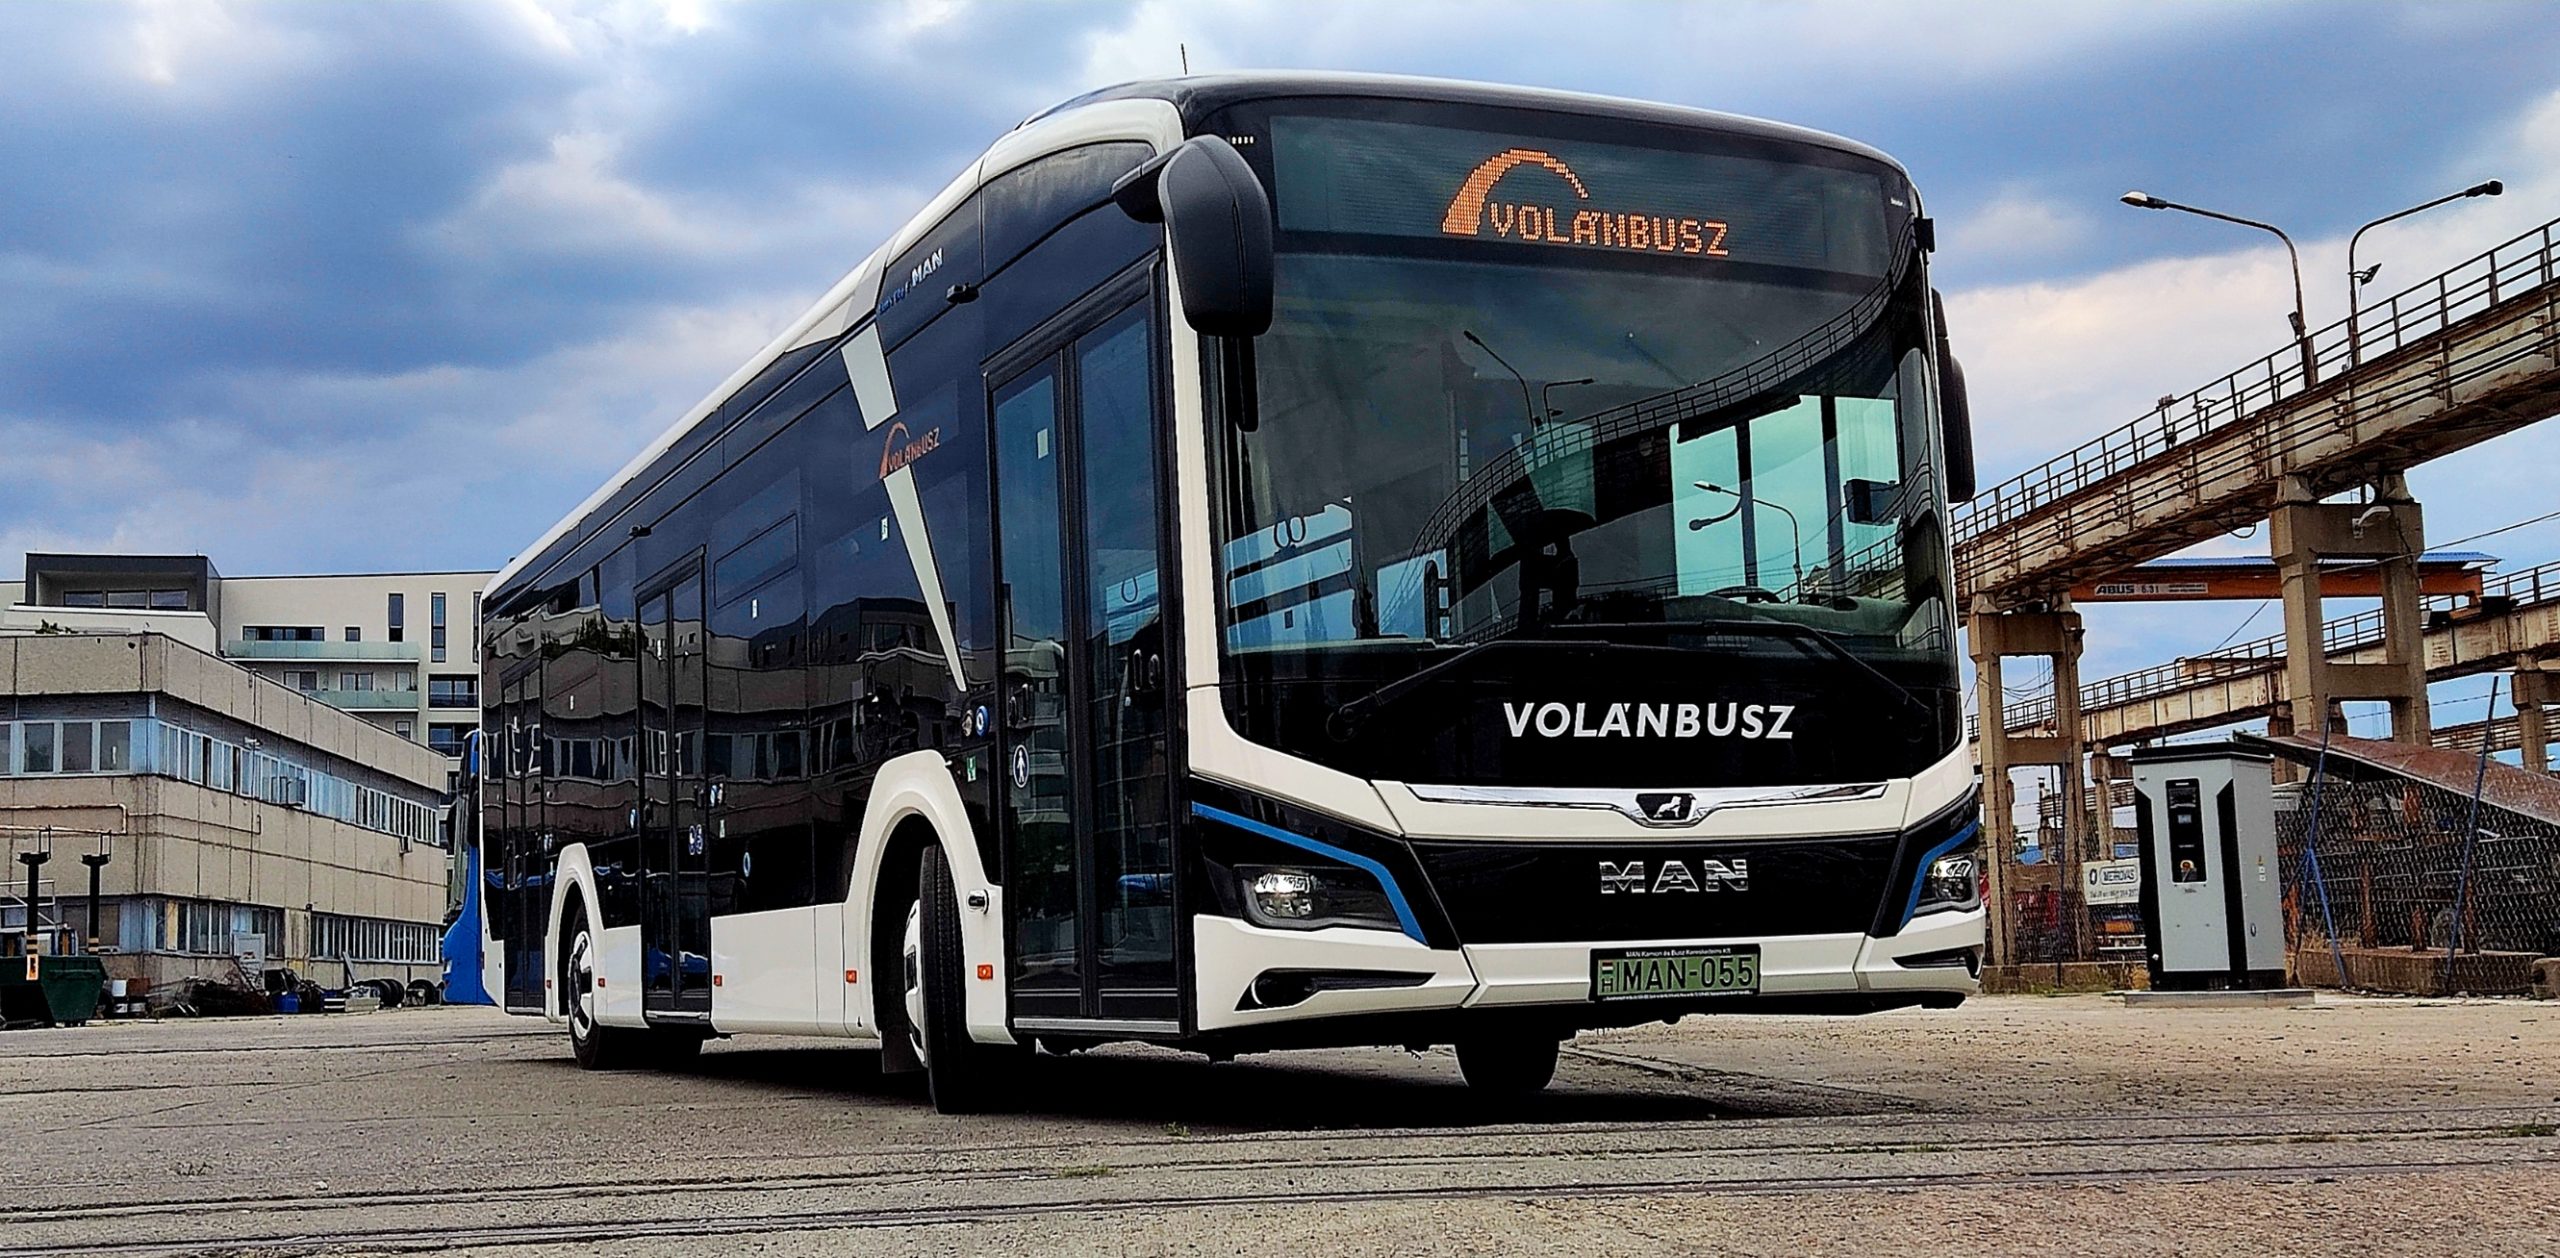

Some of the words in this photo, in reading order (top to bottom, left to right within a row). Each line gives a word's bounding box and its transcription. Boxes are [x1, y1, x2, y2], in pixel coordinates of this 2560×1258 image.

[1489, 202, 1729, 256] VOLÁNBUSZ
[911, 247, 943, 287] MAN
[2096, 585, 2135, 594] ABUS
[1502, 702, 1796, 739] VOLÁNBUSZ
[1599, 859, 1749, 893] MAN
[1601, 977, 1614, 993] H
[1622, 957, 1754, 992] MAN-055
